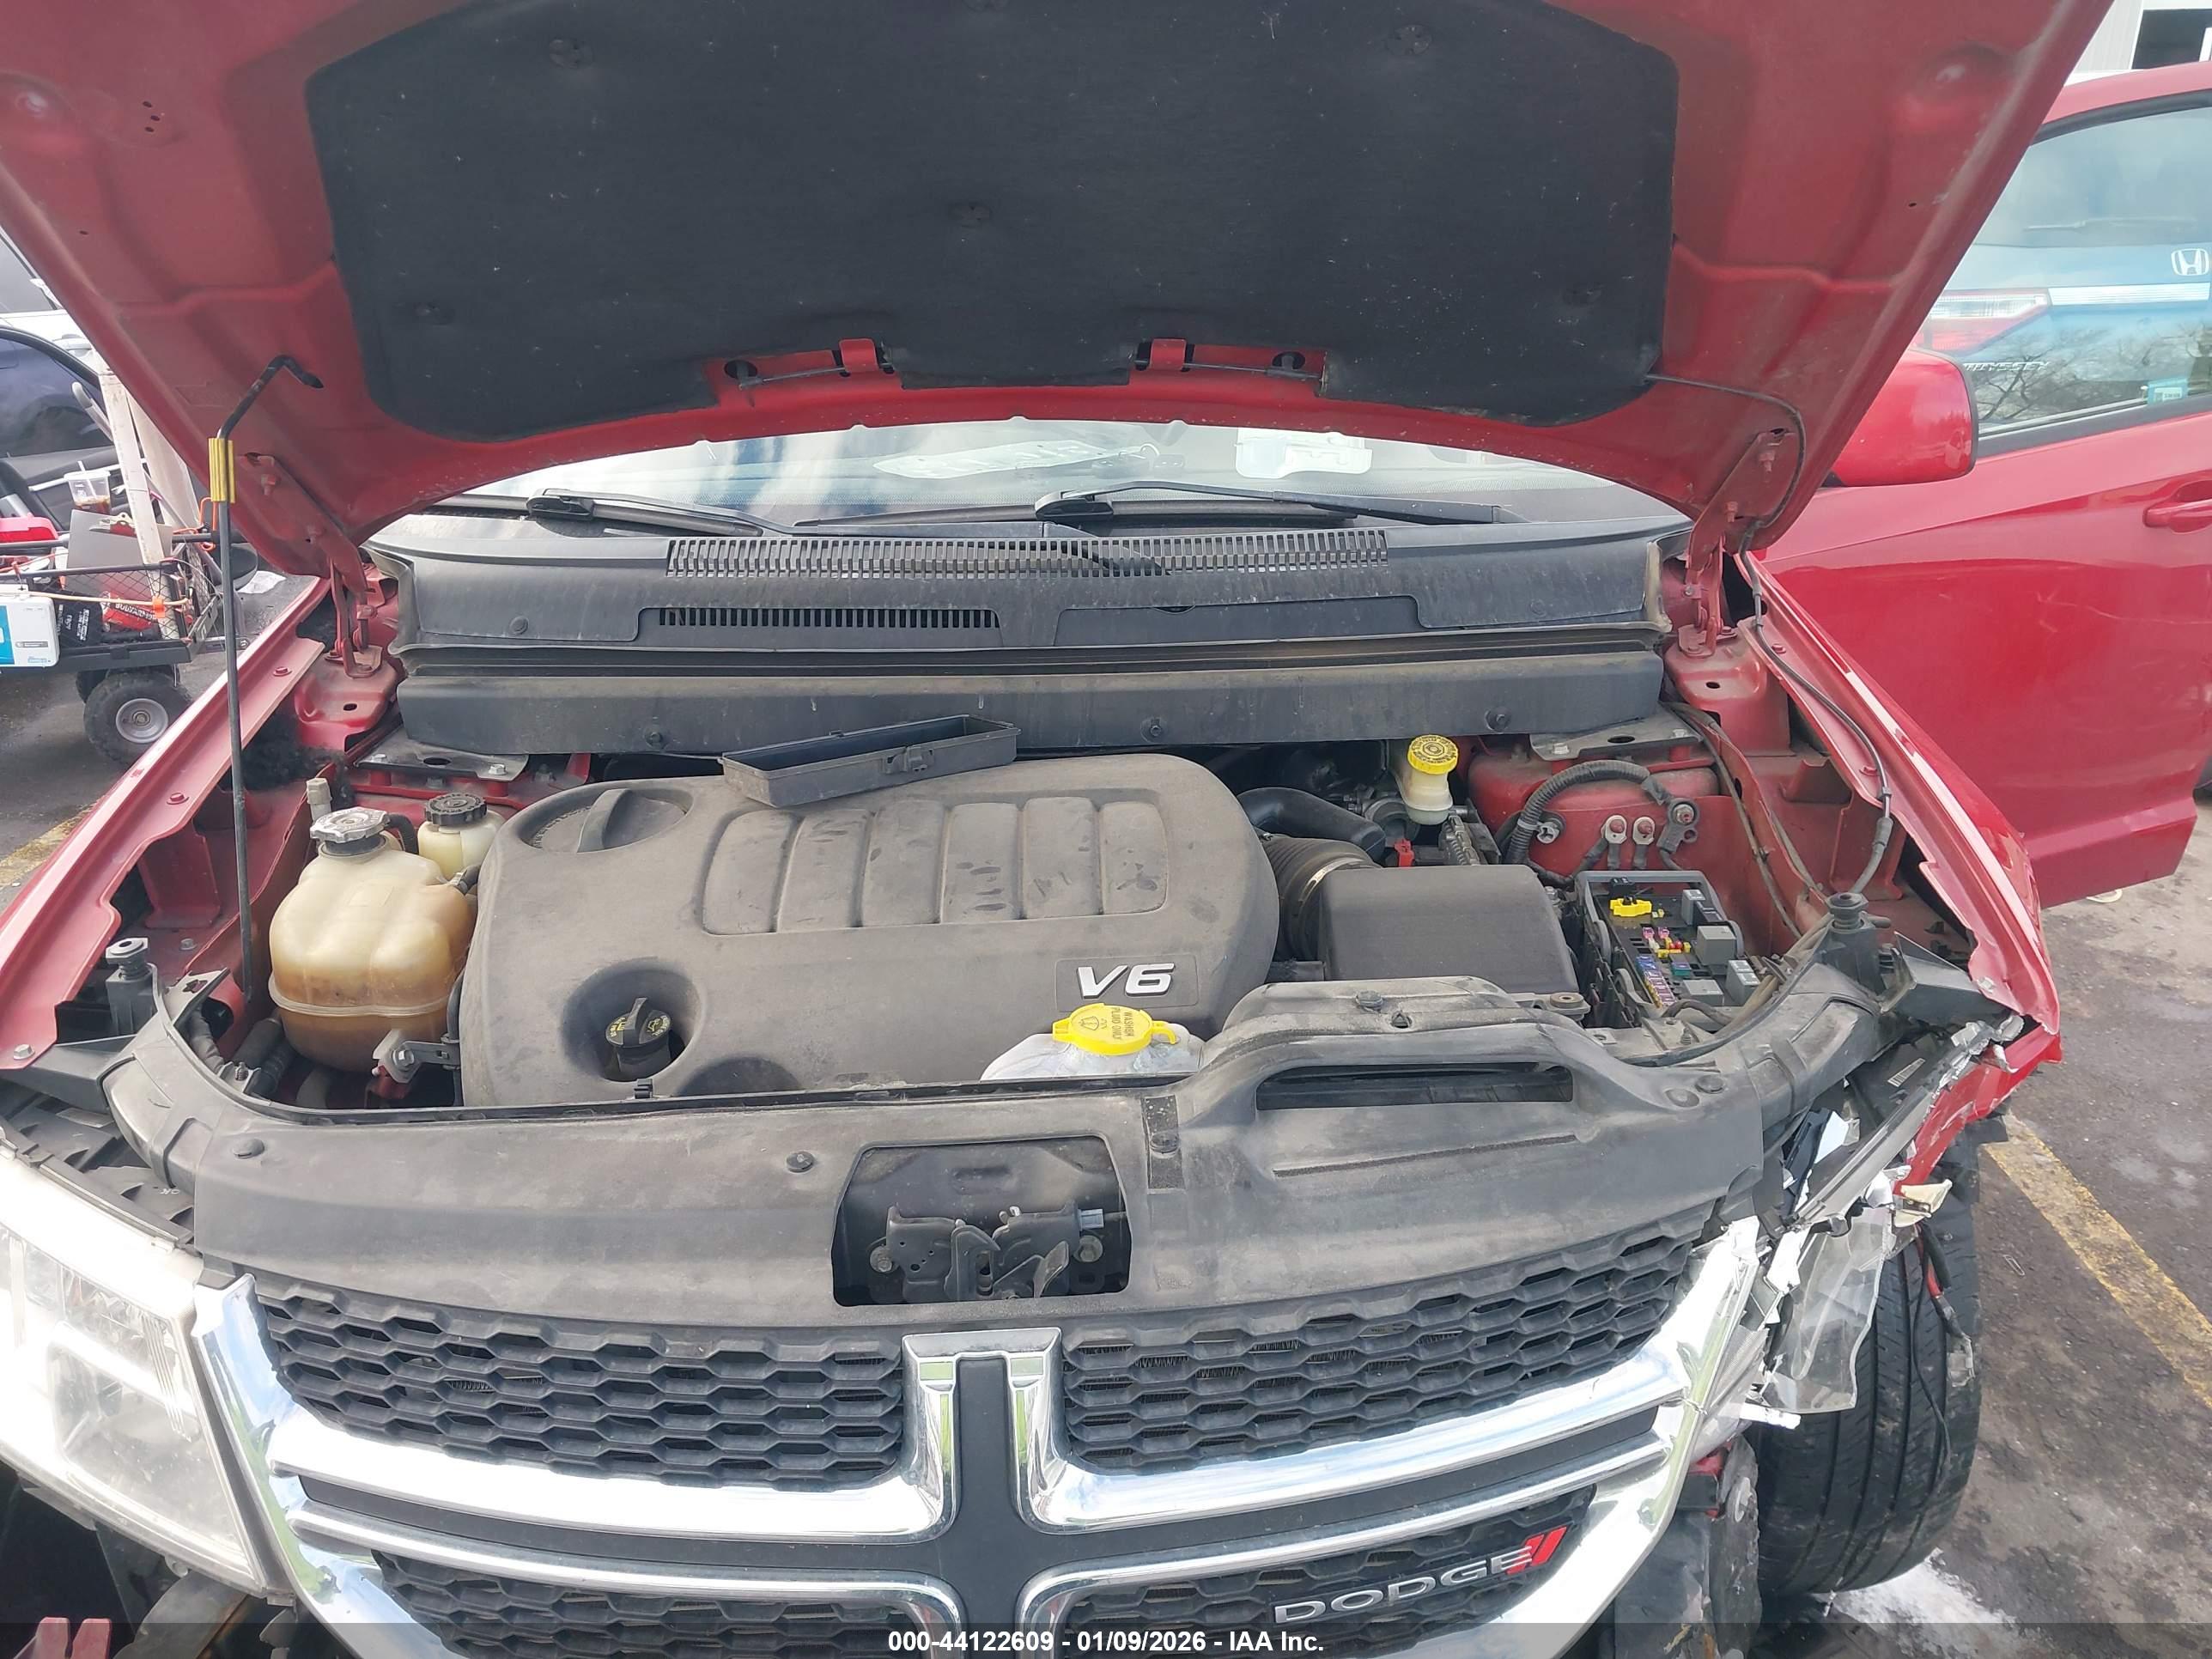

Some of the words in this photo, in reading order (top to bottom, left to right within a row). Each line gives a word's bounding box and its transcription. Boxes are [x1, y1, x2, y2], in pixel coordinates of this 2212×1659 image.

[1076, 963, 1176, 999] V6
[1111, 1006, 1121, 1024] FLUID
[1123, 1011, 1134, 1037] WASHER
[1274, 1546, 1533, 1625] DODGE
